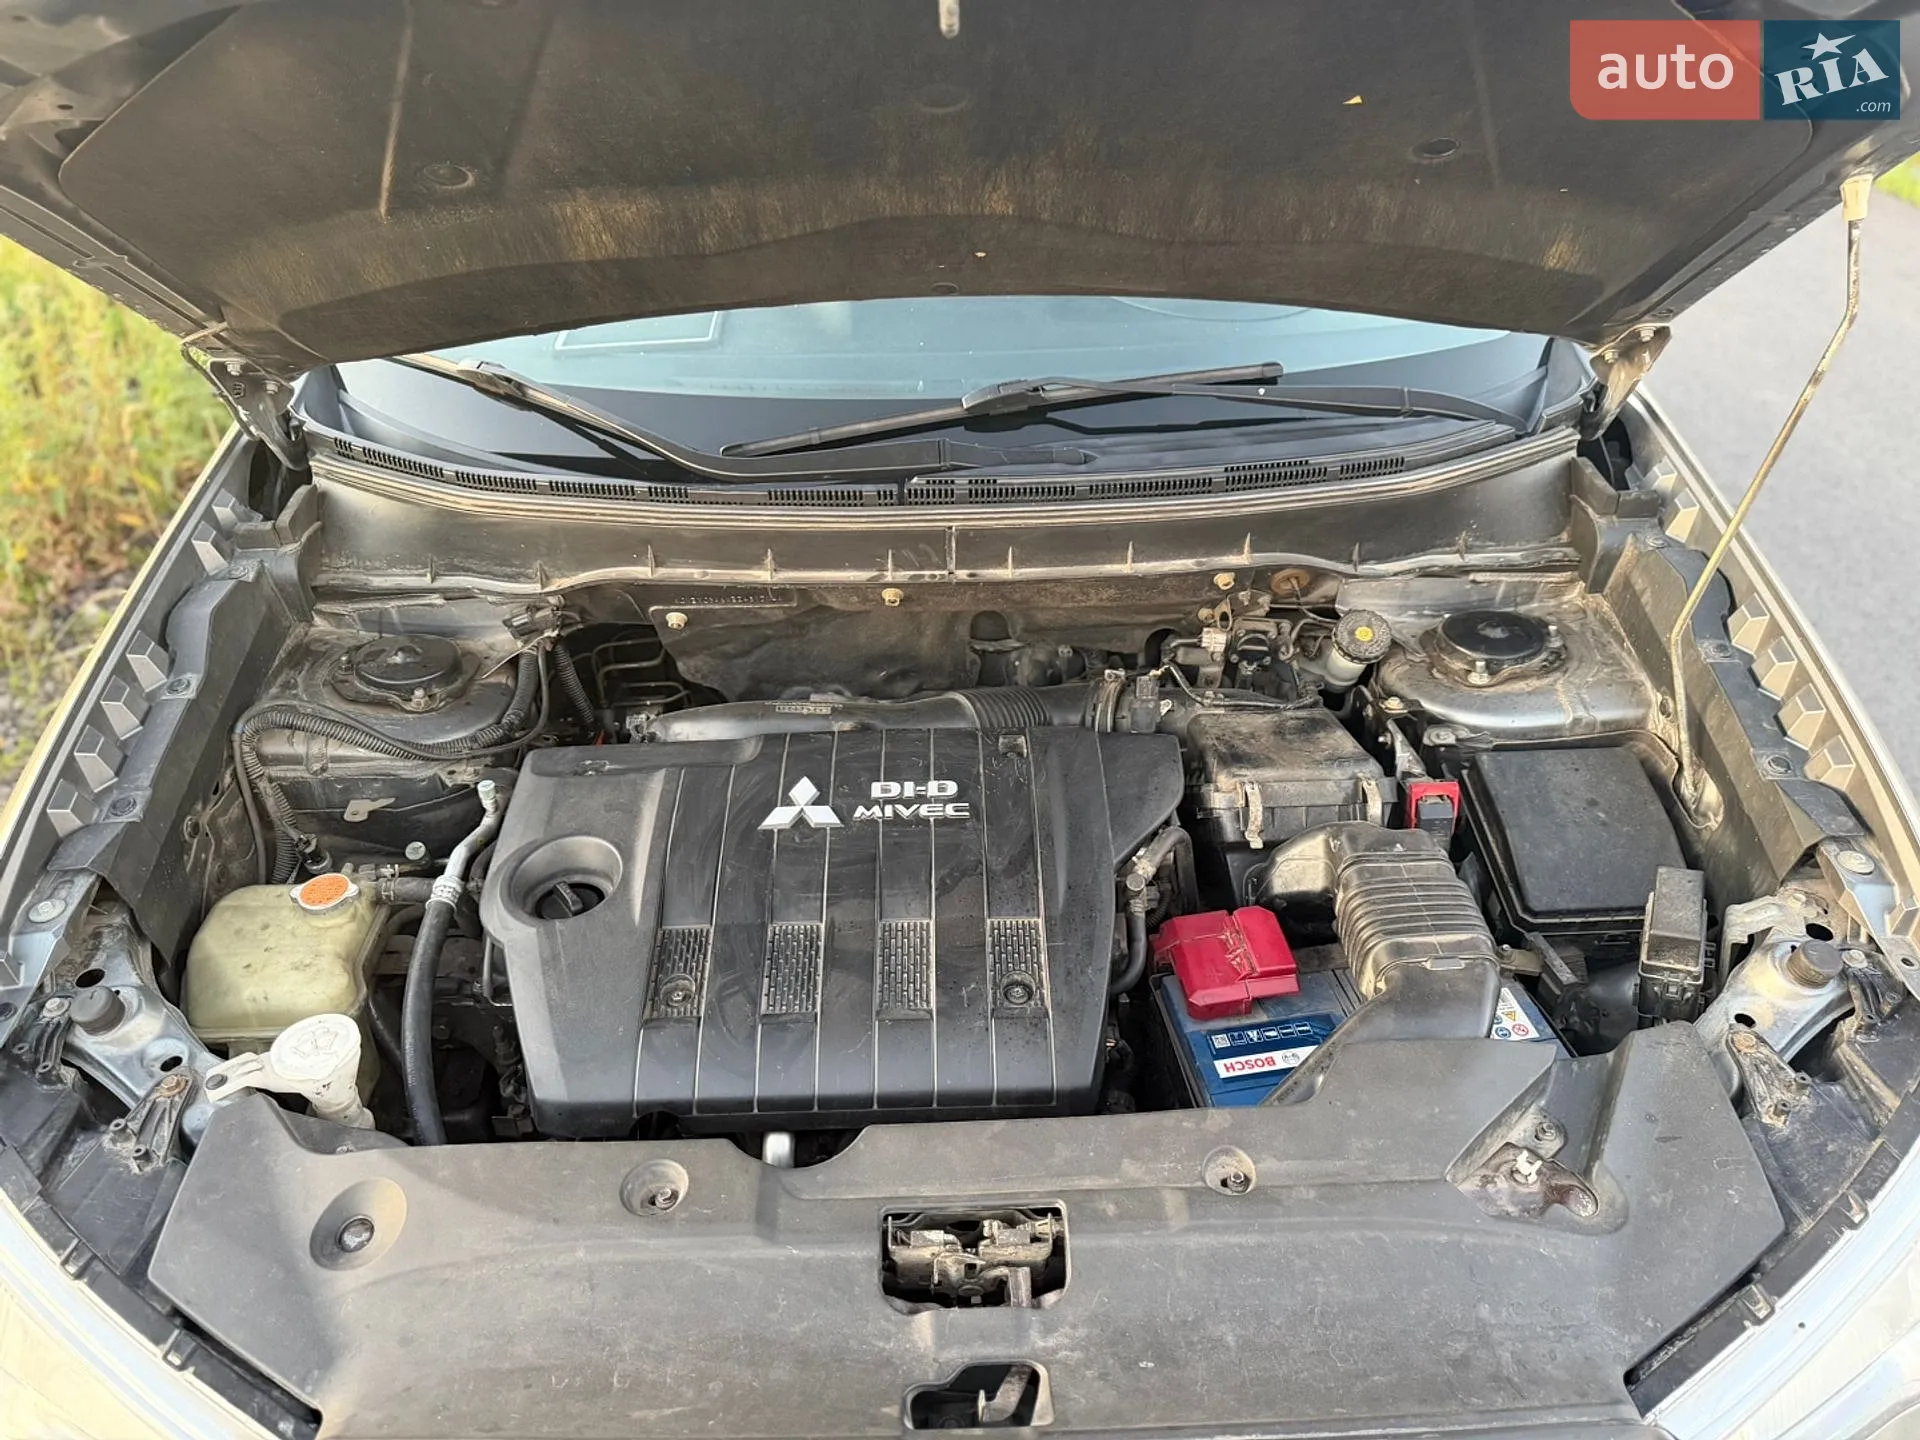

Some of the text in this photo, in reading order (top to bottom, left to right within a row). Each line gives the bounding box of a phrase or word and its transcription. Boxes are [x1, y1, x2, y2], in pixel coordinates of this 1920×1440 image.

[870, 780, 958, 799] DI-D
[852, 803, 970, 820] MIVEC
[1224, 1056, 1276, 1073] BOSCH
